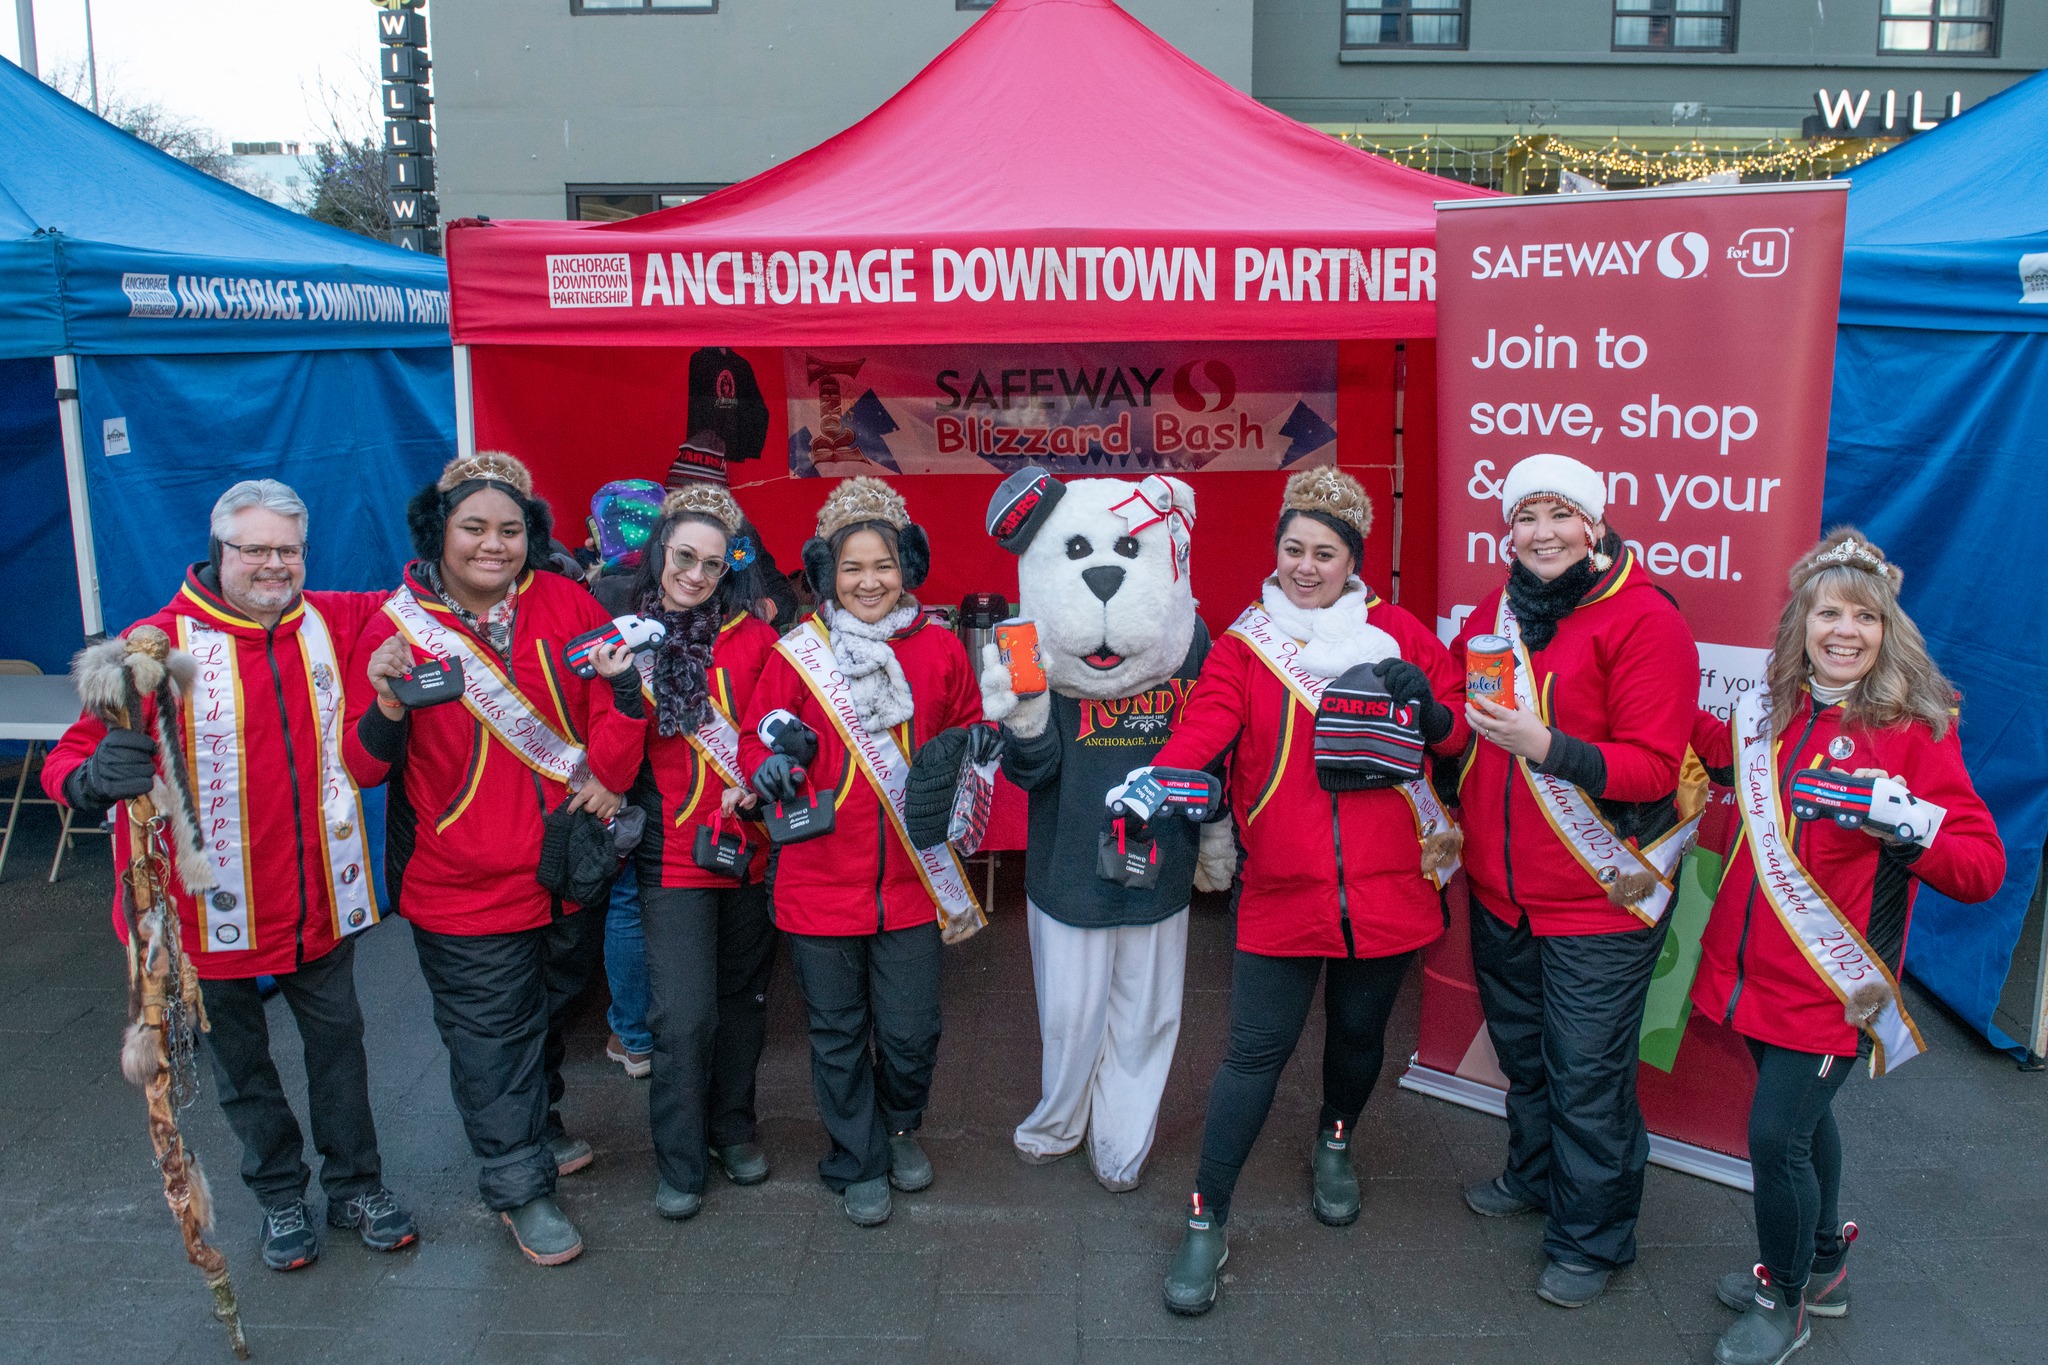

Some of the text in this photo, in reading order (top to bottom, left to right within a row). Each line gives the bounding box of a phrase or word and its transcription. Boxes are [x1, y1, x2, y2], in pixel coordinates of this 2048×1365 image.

[552, 257, 626, 274] ANCHORAGE
[641, 249, 917, 306] ANCHORAGE
[933, 246, 1216, 302] DOWNTOWN
[1471, 239, 1652, 280] SAFEWAY
[1726, 246, 1749, 260] for
[124, 278, 168, 291] ANCHORAGE
[177, 275, 304, 320] ANCHORAGE
[303, 281, 405, 323] DOWNTOWN
[553, 274, 628, 290] DOWNTOWN
[553, 290, 628, 305] PARTNERSHIP
[134, 303, 176, 317] PARTNERSHIP
[1471, 324, 1648, 369] Join to
[936, 366, 1166, 412] SAFEWAY
[934, 411, 1264, 455] Blizzard Bash
[1469, 394, 1758, 455] save, shop
[1468, 459, 1504, 500] &
[1655, 473, 1781, 522] your
[998, 490, 1040, 536] CARRS
[1244, 616, 1273, 645] Fur
[192, 642, 223, 722] Lord
[1321, 697, 1389, 717] CARRS
[508, 717, 580, 774] Princess
[1085, 736, 1147, 747] ANCHORAGE,
[795, 637, 822, 673] Fur
[936, 878, 964, 902] 2025
[1817, 780, 1840, 790] SAFEWAY
[202, 733, 230, 868] Trapper
[1420, 797, 1440, 818] 2025
[1573, 817, 1622, 861] 2025
[1749, 753, 1874, 982] Lady Trapper 2025
